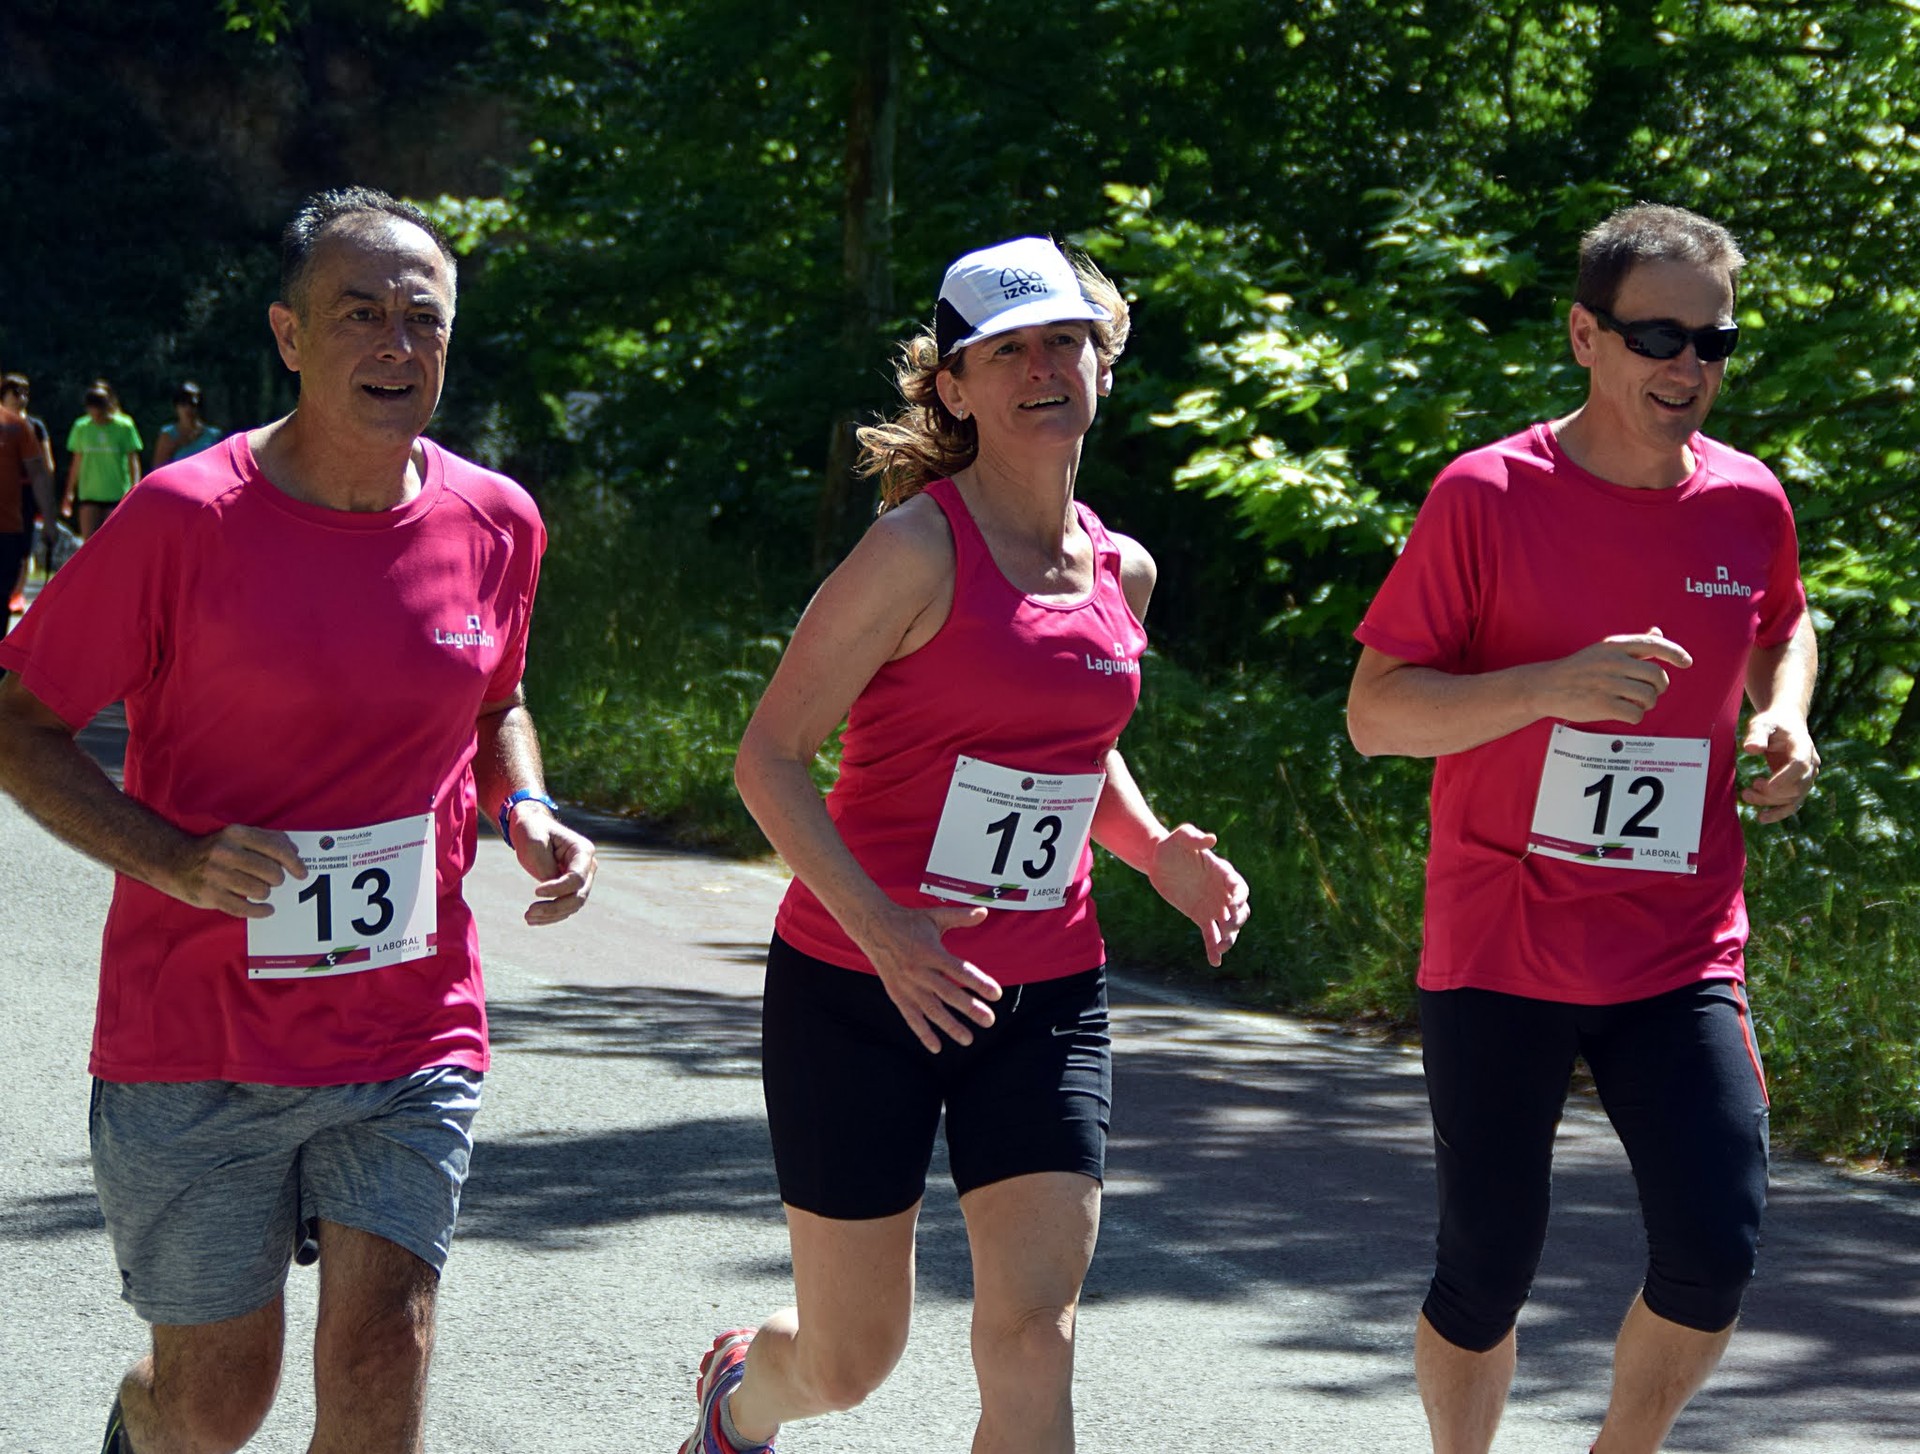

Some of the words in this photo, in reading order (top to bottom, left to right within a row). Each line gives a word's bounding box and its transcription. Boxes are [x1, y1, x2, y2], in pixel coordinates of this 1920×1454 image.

[1003, 281, 1048, 300] izadi
[1686, 577, 1752, 598] LagunAro
[1086, 653, 1140, 676] LagunAr
[1584, 774, 1665, 839] 12
[336, 831, 373, 842] mundukide
[986, 811, 1063, 880] 13
[352, 859, 367, 867] ENTRE
[367, 852, 400, 865] COOPERATIVAS
[358, 850, 379, 859] CARRERA
[1640, 848, 1681, 859] LABORAL
[1032, 887, 1061, 897] LABORAL
[298, 867, 395, 942] 13
[377, 936, 420, 953] LABORAL
